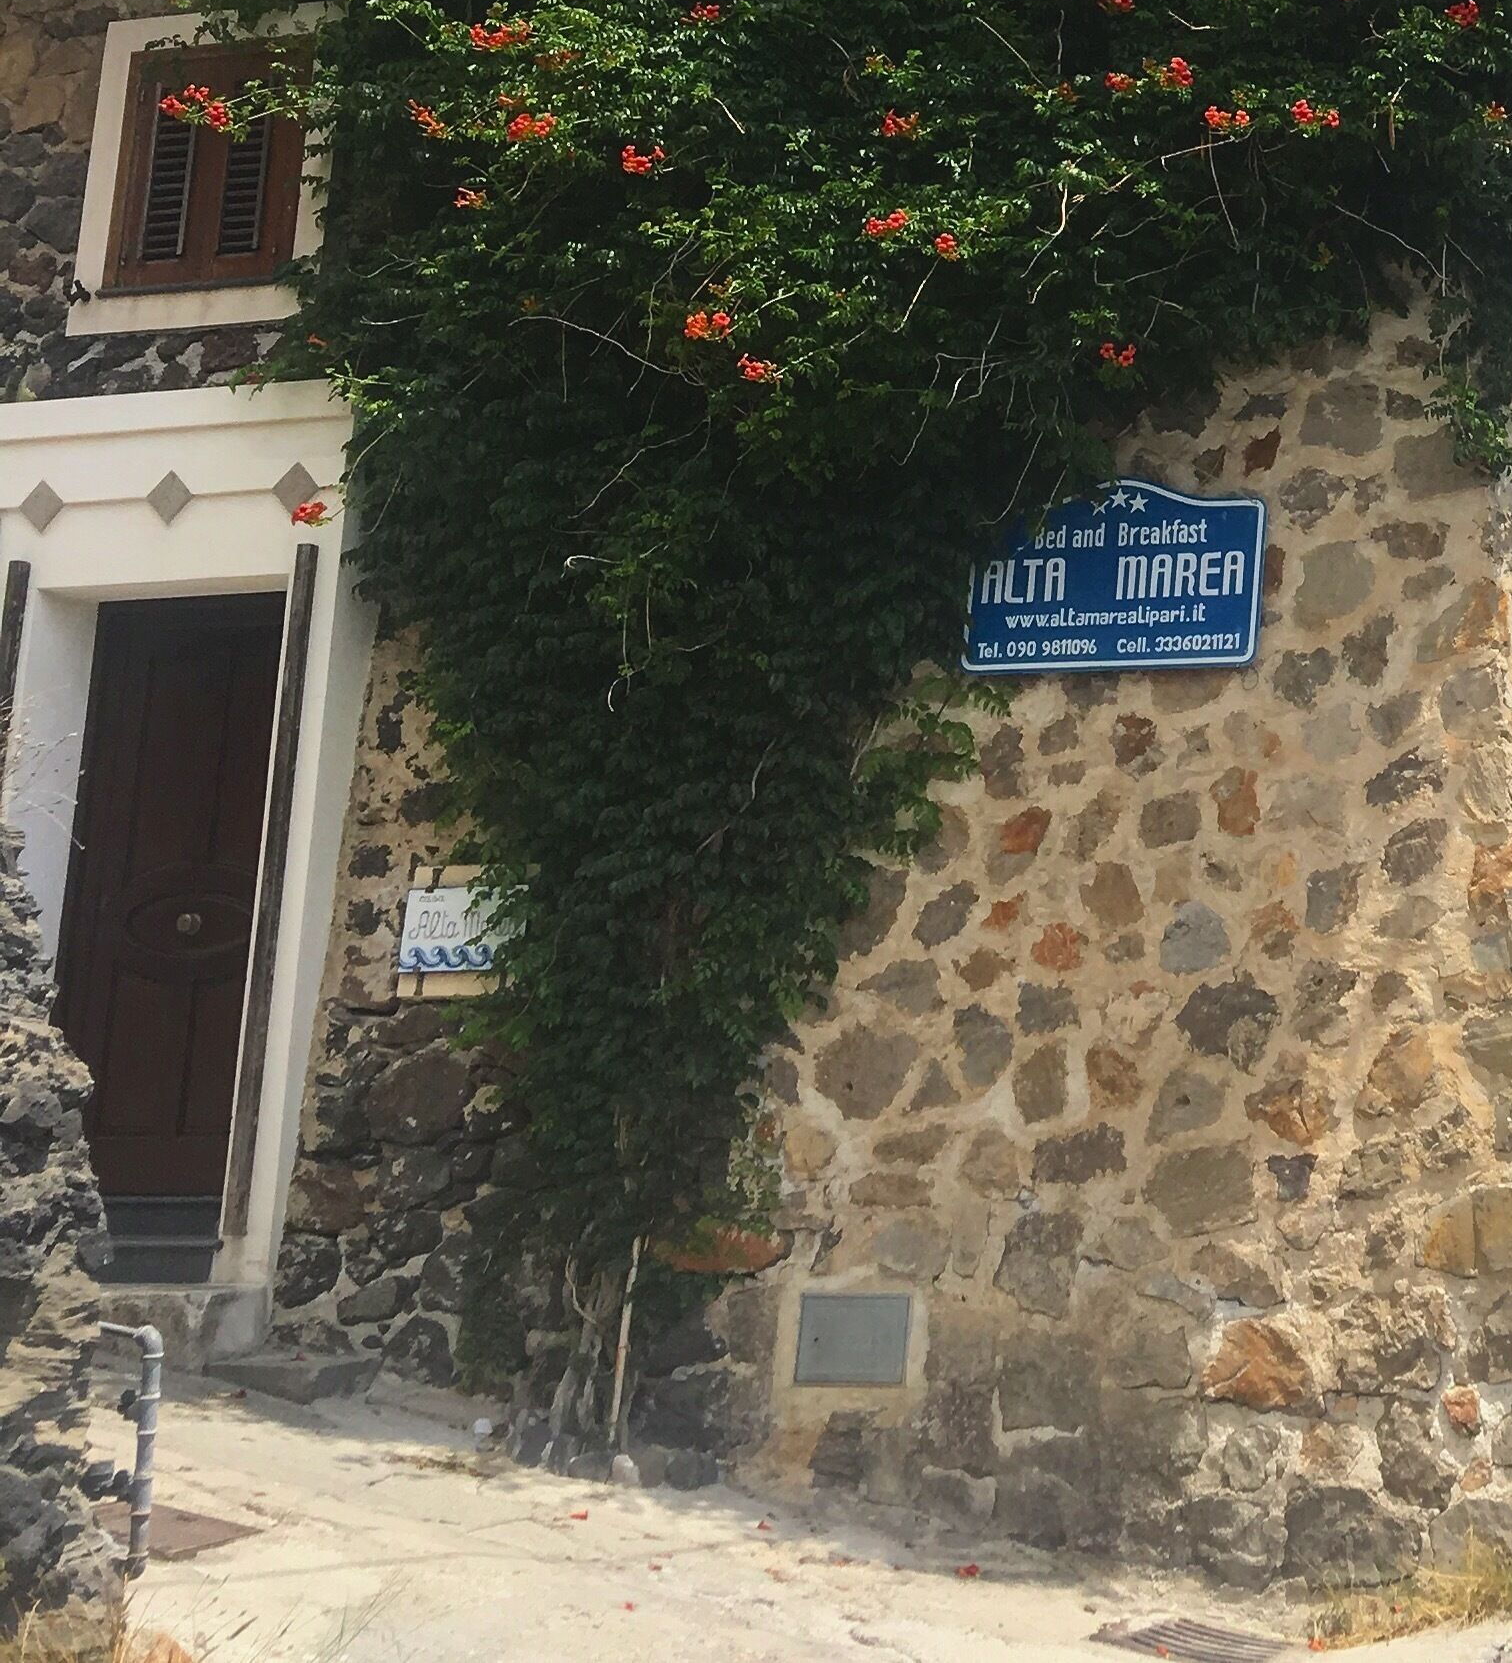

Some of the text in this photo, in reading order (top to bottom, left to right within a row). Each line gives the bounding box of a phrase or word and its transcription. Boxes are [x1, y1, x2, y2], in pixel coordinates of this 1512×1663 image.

[1035, 519, 1207, 549] Bed and Breakfast
[981, 550, 1245, 604] ALTA MAREA
[1005, 603, 1206, 629] www.altamarealipari.it
[978, 633, 1240, 658] Tel. 090 9811096 Cell. 3336021121
[408, 910, 460, 940] Alta
